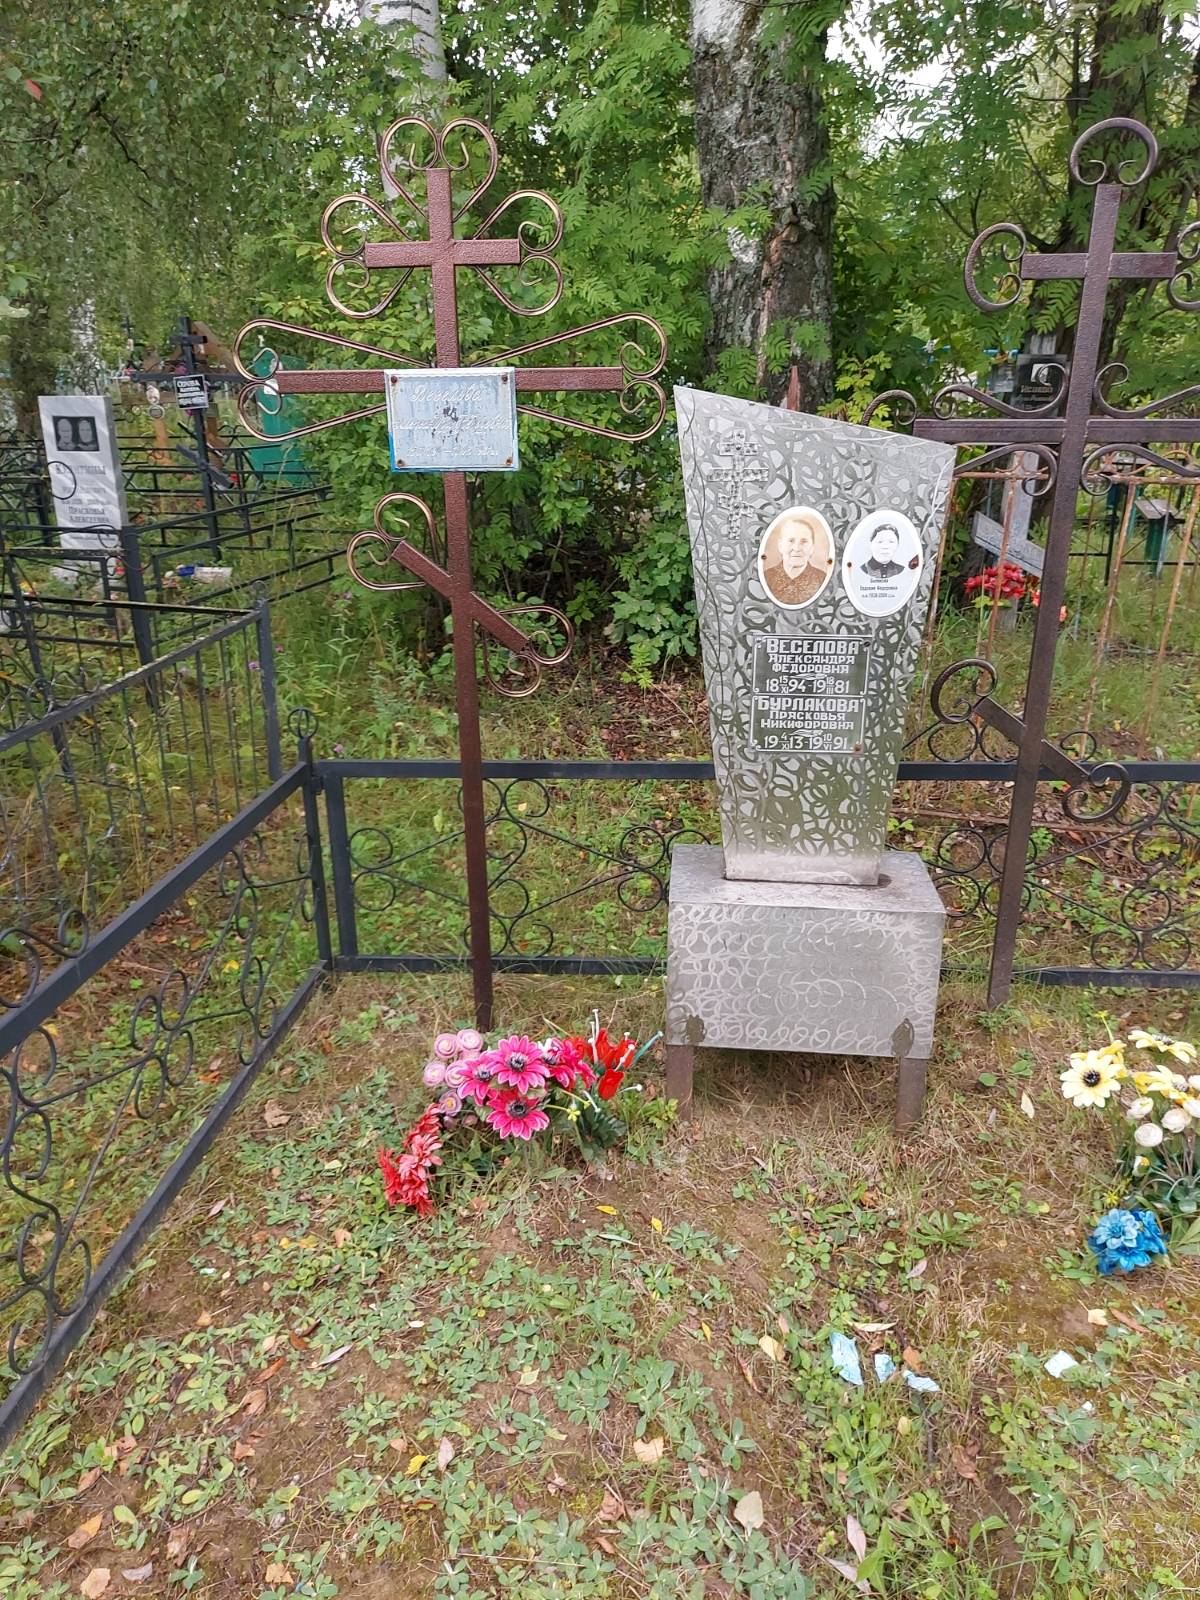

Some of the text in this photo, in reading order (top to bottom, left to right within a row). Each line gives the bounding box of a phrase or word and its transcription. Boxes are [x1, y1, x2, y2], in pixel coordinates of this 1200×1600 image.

[766, 639, 859, 654] ВЕСЕЛОВА
[768, 654, 855, 664] АЛЕКСАНДРА
[772, 664, 849, 673] ФЕДОРОВНА
[758, 696, 859, 712] БУРЛАКОВА
[769, 711, 845, 720] ПРАСКОВЬЯ
[760, 719, 854, 729] НИКИФОРОВНА
